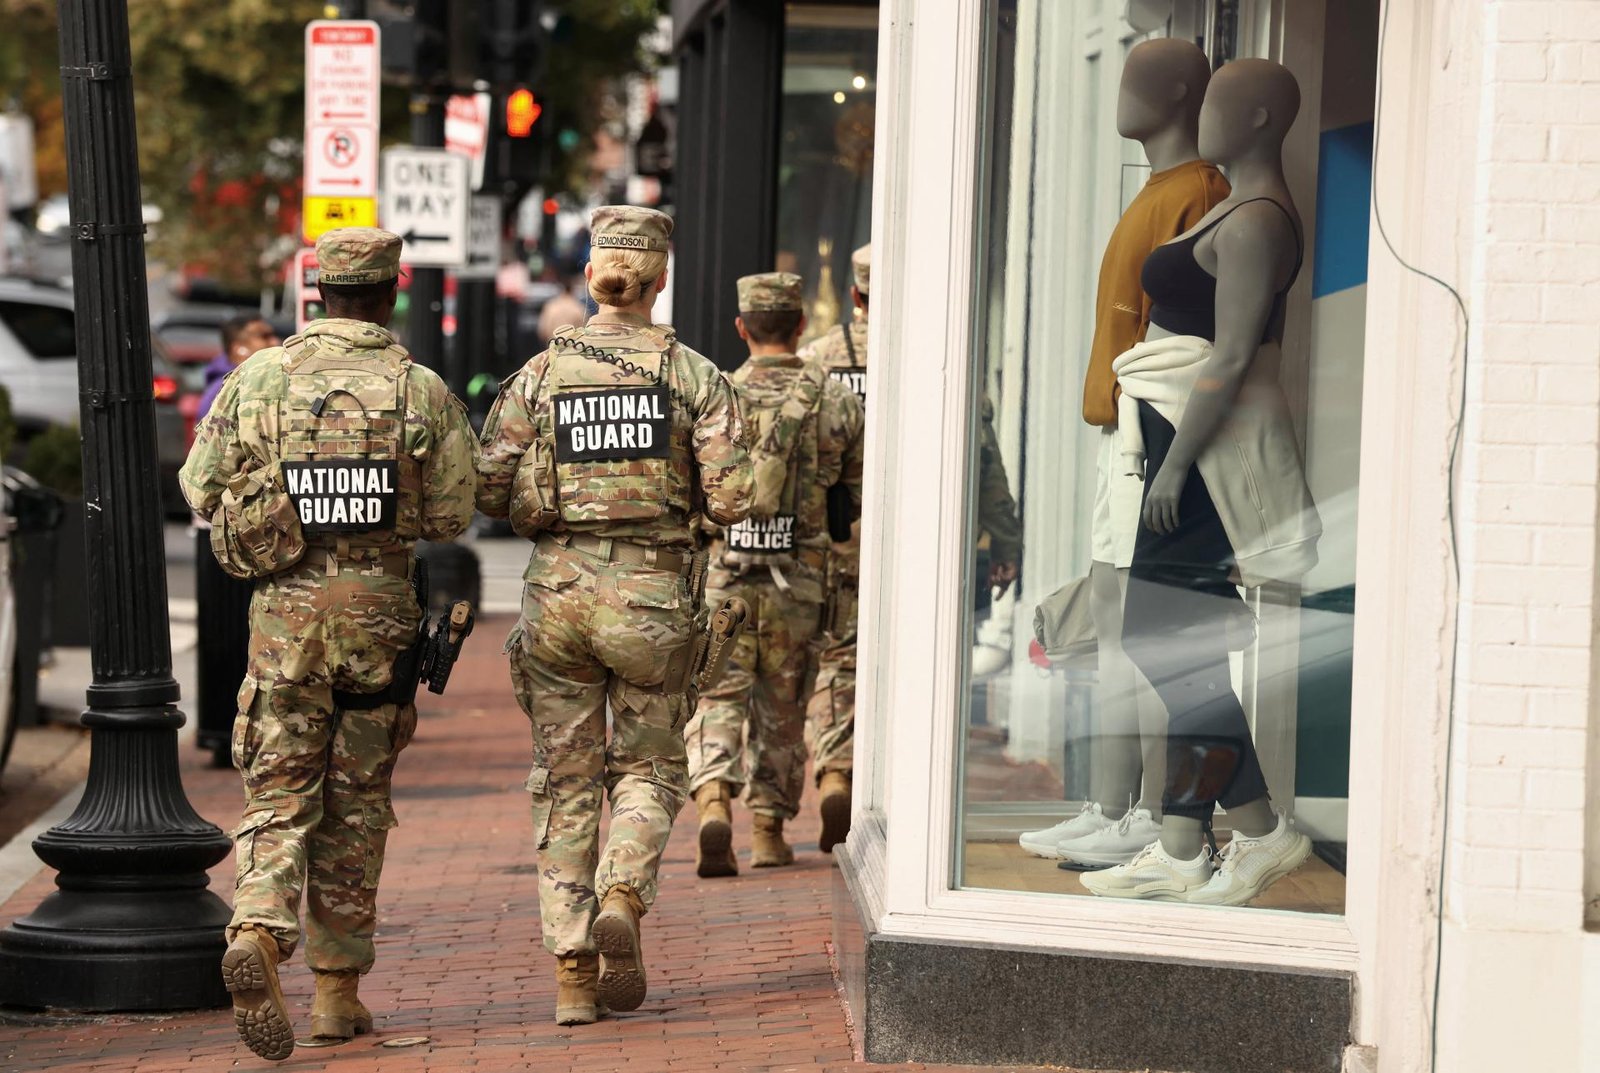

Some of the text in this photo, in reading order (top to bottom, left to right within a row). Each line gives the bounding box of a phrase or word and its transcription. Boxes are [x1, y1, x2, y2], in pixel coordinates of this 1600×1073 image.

[393, 160, 456, 188] ONE
[394, 194, 455, 219] WAY
[598, 236, 645, 247] EDMONDSON
[325, 274, 369, 284] BARRETT
[559, 394, 665, 426] NATIONAL
[571, 422, 653, 453] GUARD
[286, 467, 394, 495] NATIONAL
[299, 497, 382, 525] GUARD
[730, 530, 792, 549] POLICE
